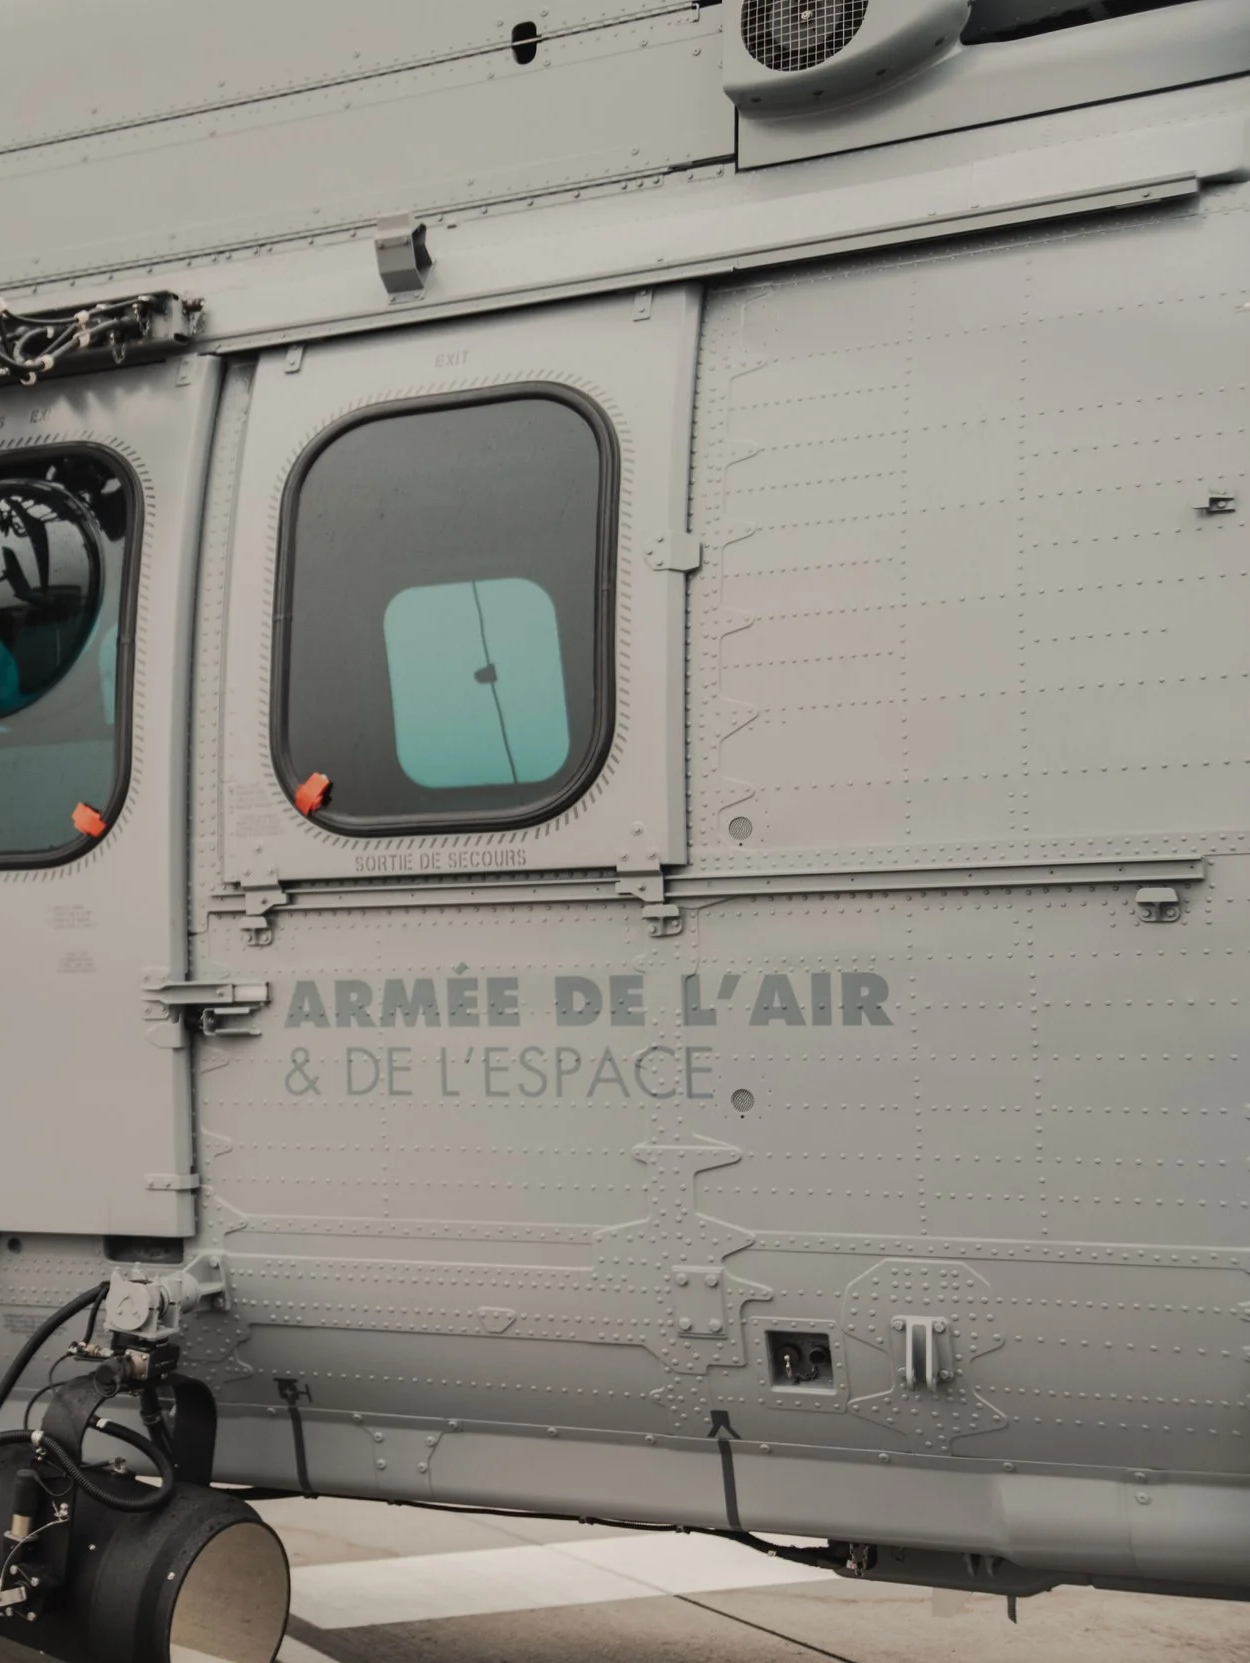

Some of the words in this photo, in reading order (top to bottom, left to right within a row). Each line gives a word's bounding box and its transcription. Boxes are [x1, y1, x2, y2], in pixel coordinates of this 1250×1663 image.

[435, 349, 471, 368] EXIT
[355, 854, 412, 873] SORTIE
[420, 852, 440, 870] DE
[448, 849, 527, 869] SECOURS
[284, 961, 520, 1028] ARMÉE
[554, 974, 645, 1028] DE
[682, 971, 894, 1027] L'AIR
[284, 1046, 322, 1097] &
[345, 1046, 412, 1097] DE
[441, 1045, 714, 1100] L'ESPACE
